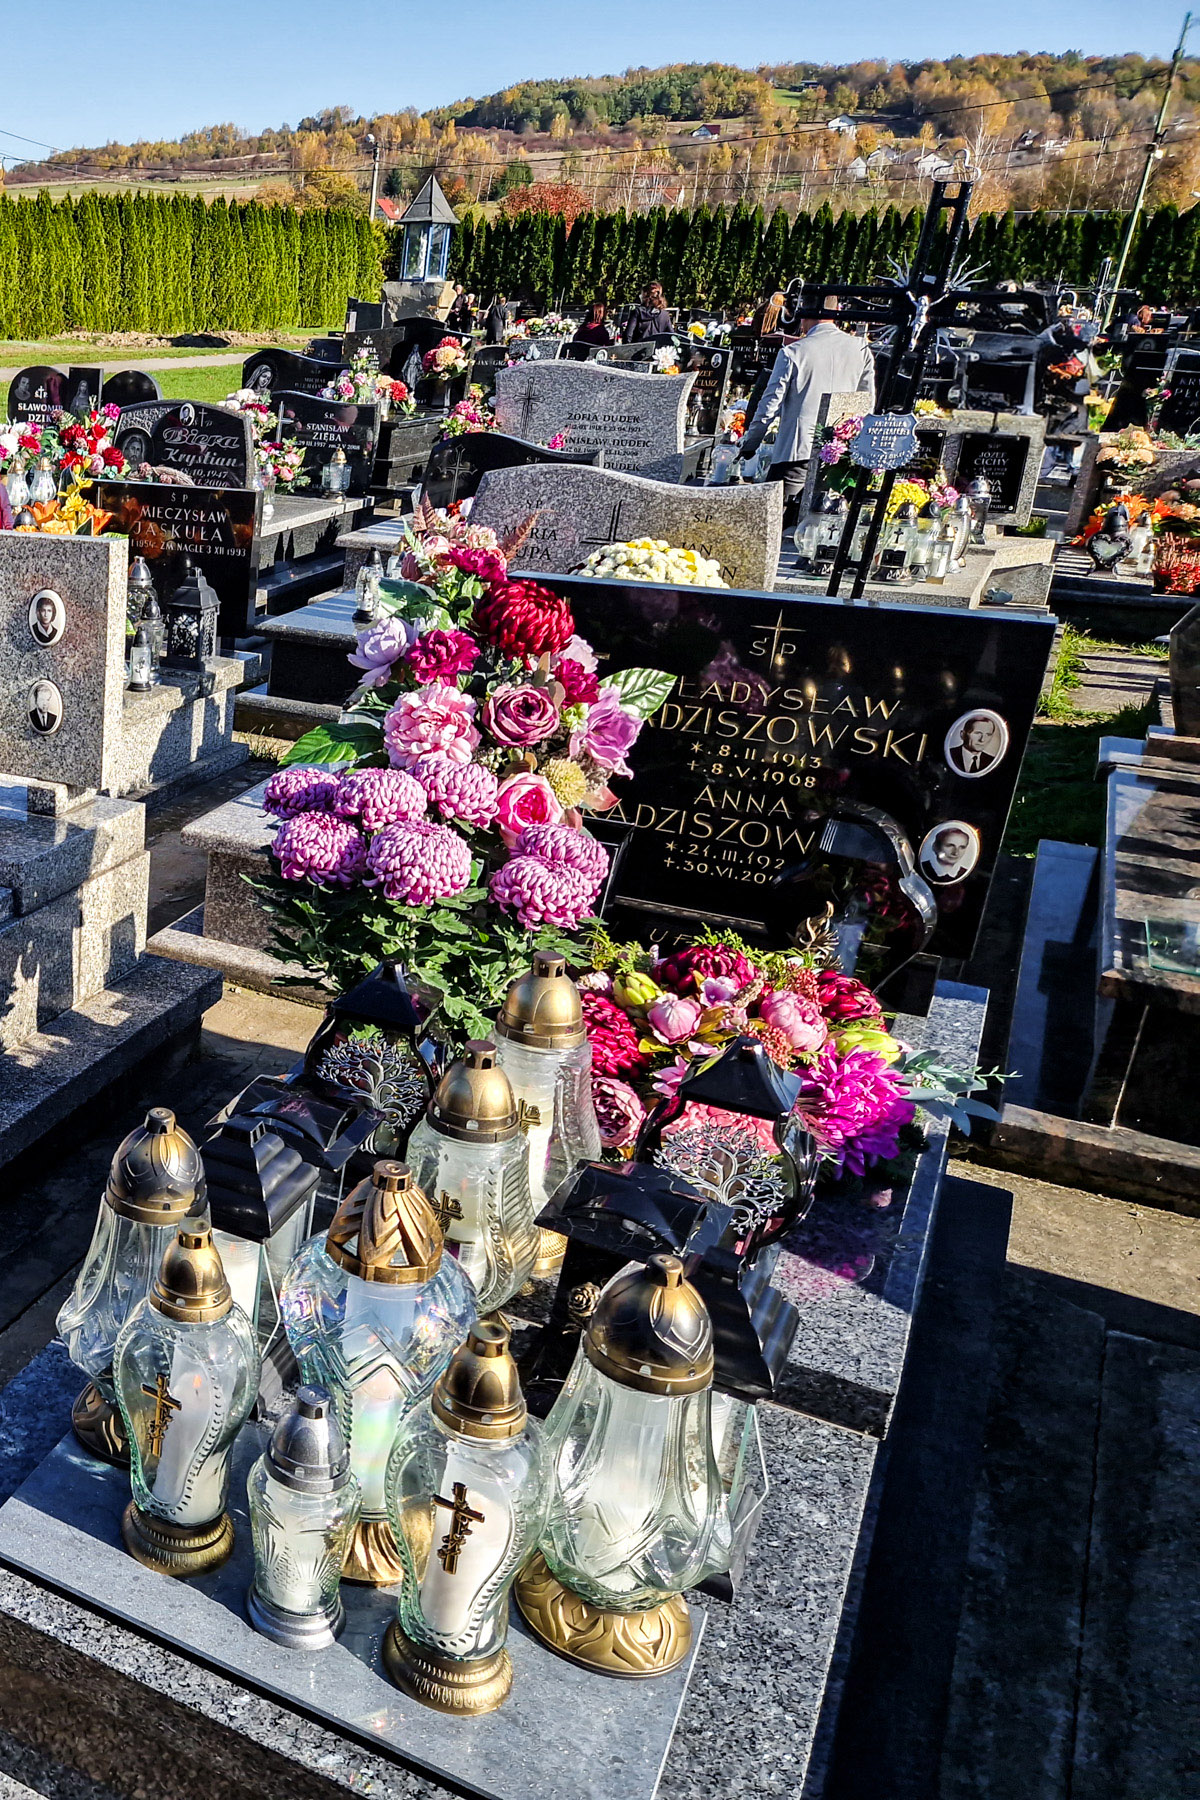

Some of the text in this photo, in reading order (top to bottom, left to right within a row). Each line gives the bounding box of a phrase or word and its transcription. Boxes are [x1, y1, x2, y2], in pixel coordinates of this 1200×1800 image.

[567, 412, 641, 424] ZOFIA DUDEK
[312, 432, 342, 442] ZIĘBA
[612, 439, 653, 448] DUDEK
[161, 447, 238, 467] Krystian
[603, 461, 641, 472] DUDEK
[140, 505, 227, 523] MIECZYSŁAW
[133, 520, 224, 542] JASKUŁA
[503, 525, 558, 541] MRIA
[177, 542, 205, 554] NAGLE
[206, 545, 212, 554] 3
[214, 546, 225, 556] XII
[227, 548, 246, 557] 1993
[780, 642, 797, 658] P
[676, 675, 900, 721] ŁADYSŁAW
[647, 701, 928, 767] DZISZOWSKI
[693, 784, 793, 820] ANNA
